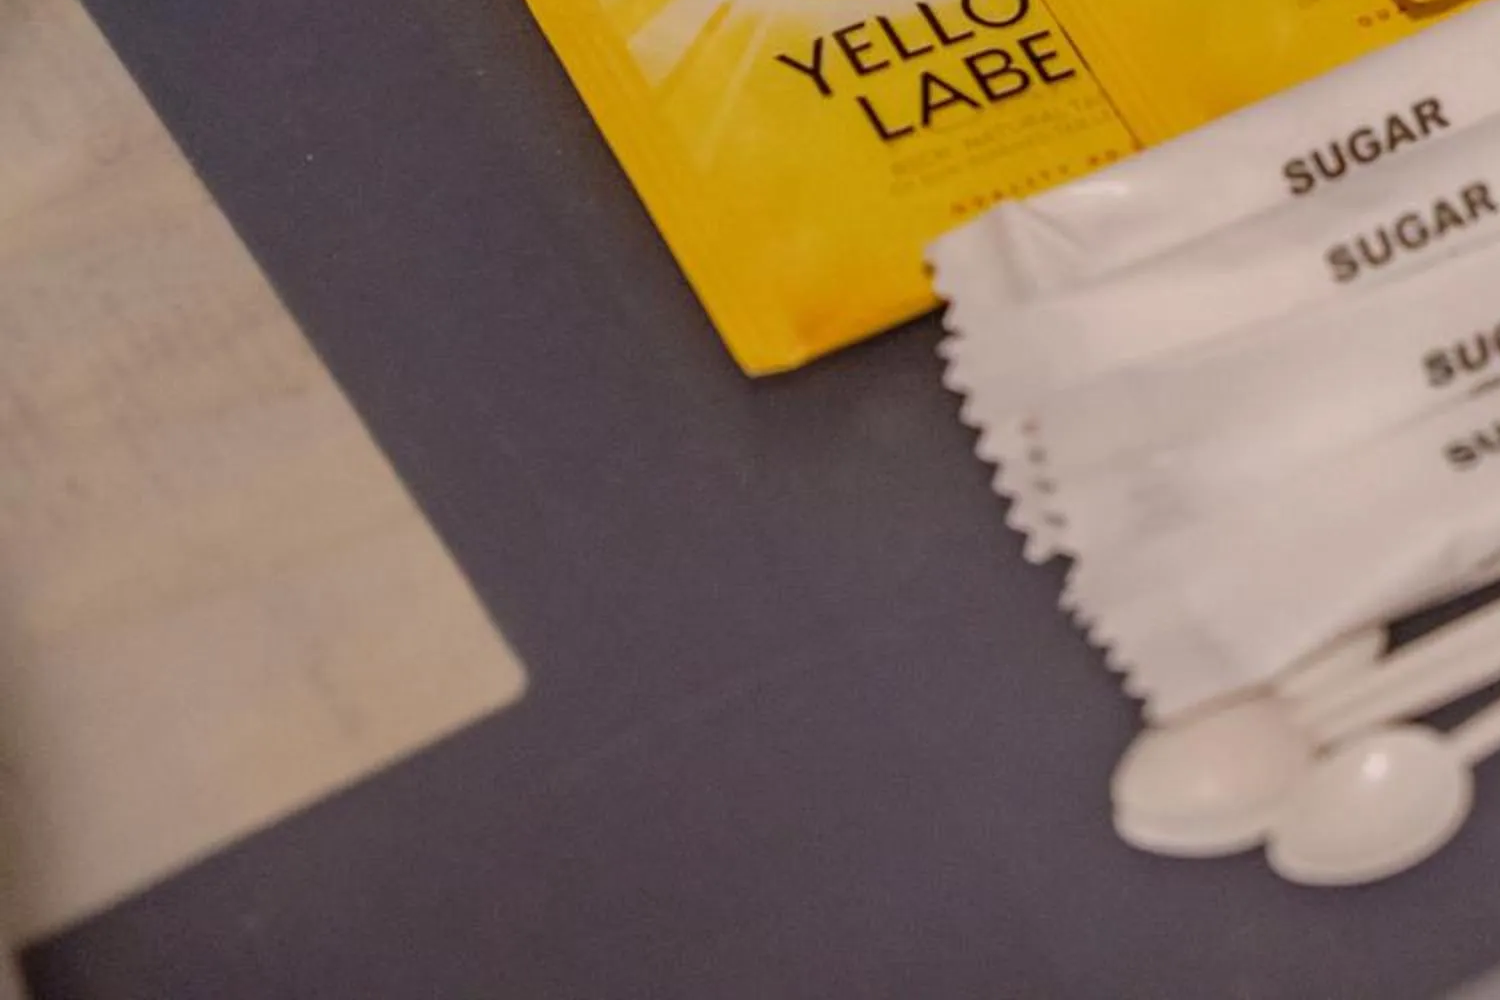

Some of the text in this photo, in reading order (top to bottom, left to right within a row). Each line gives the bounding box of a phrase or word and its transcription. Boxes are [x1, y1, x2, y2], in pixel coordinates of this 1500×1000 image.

[856, 30, 1076, 142] LABE
[1282, 98, 1450, 196] SUGAR
[1324, 181, 1500, 284] SUGAR
